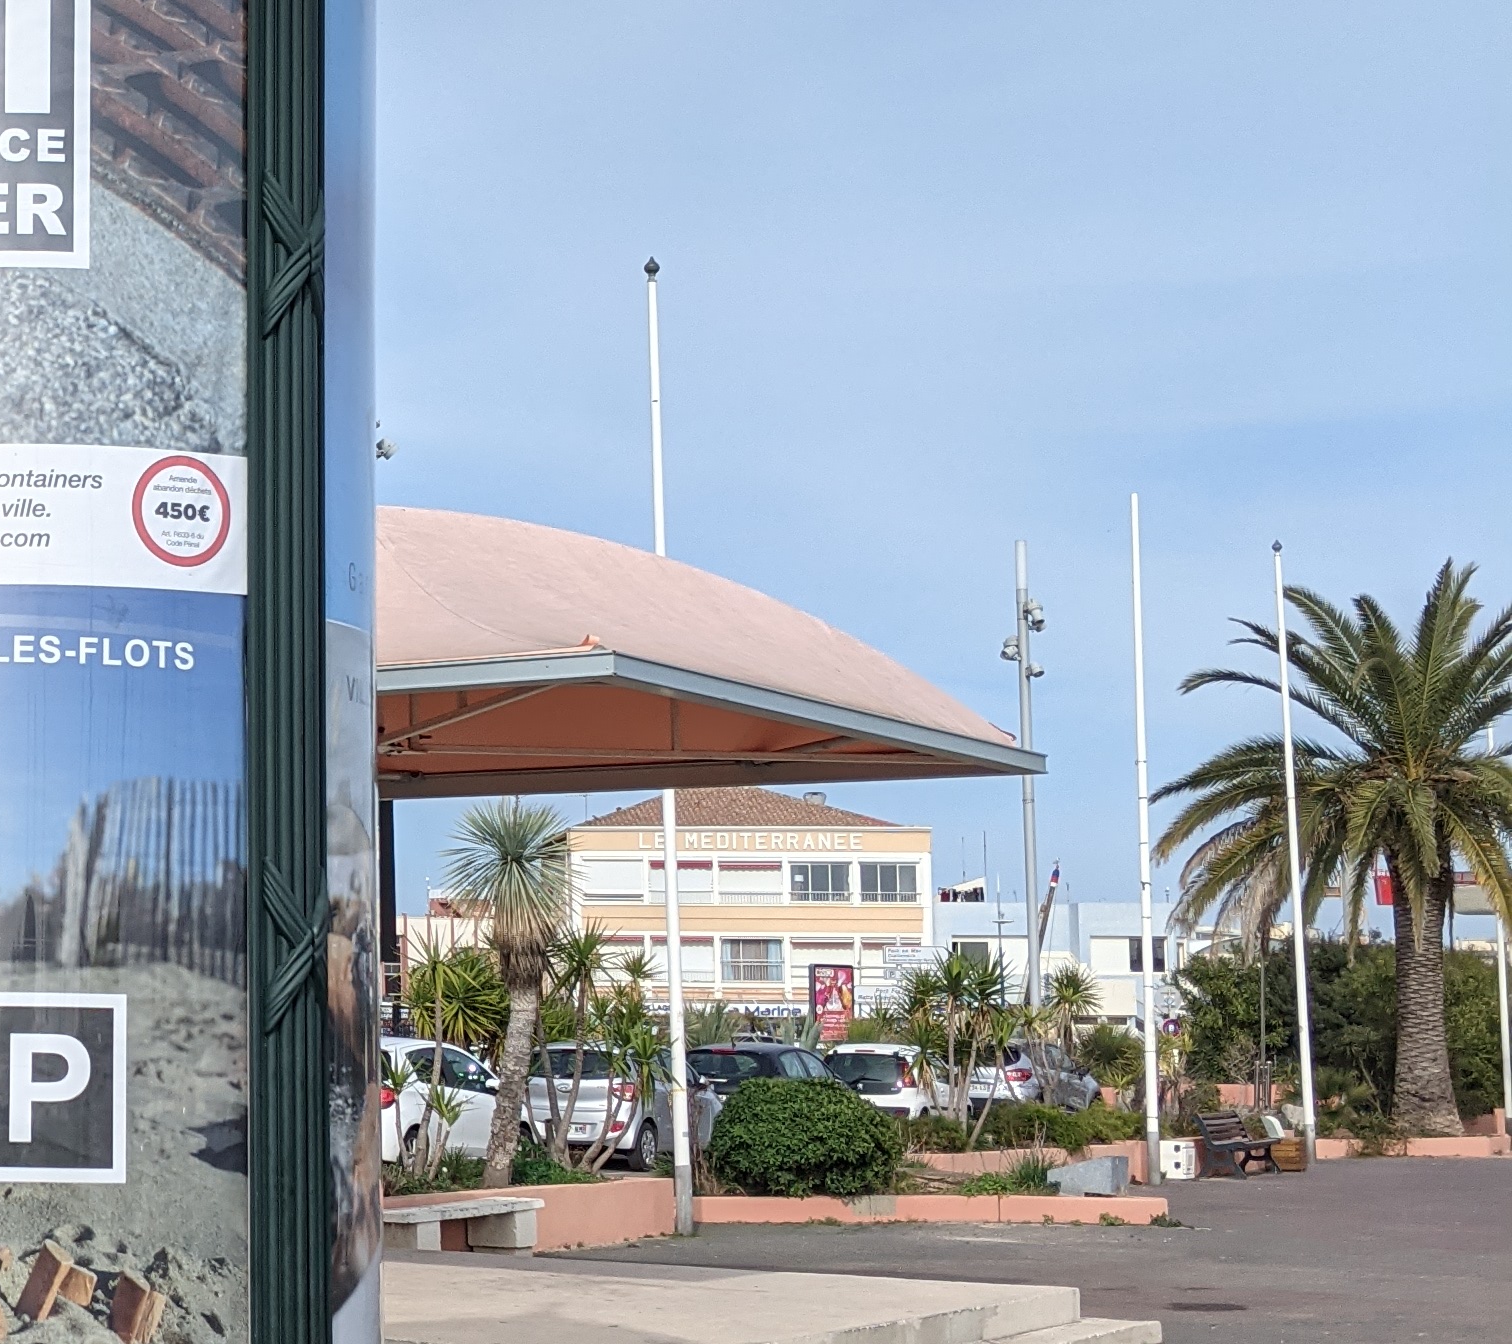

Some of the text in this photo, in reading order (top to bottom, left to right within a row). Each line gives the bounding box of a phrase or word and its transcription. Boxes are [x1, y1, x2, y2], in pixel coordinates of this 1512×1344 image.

[1, 498, 52, 518] ville.
[154, 501, 211, 523] 450€
[638, 831, 863, 850] LE MEDITERRANEE
[744, 1005, 802, 1017] Marine
